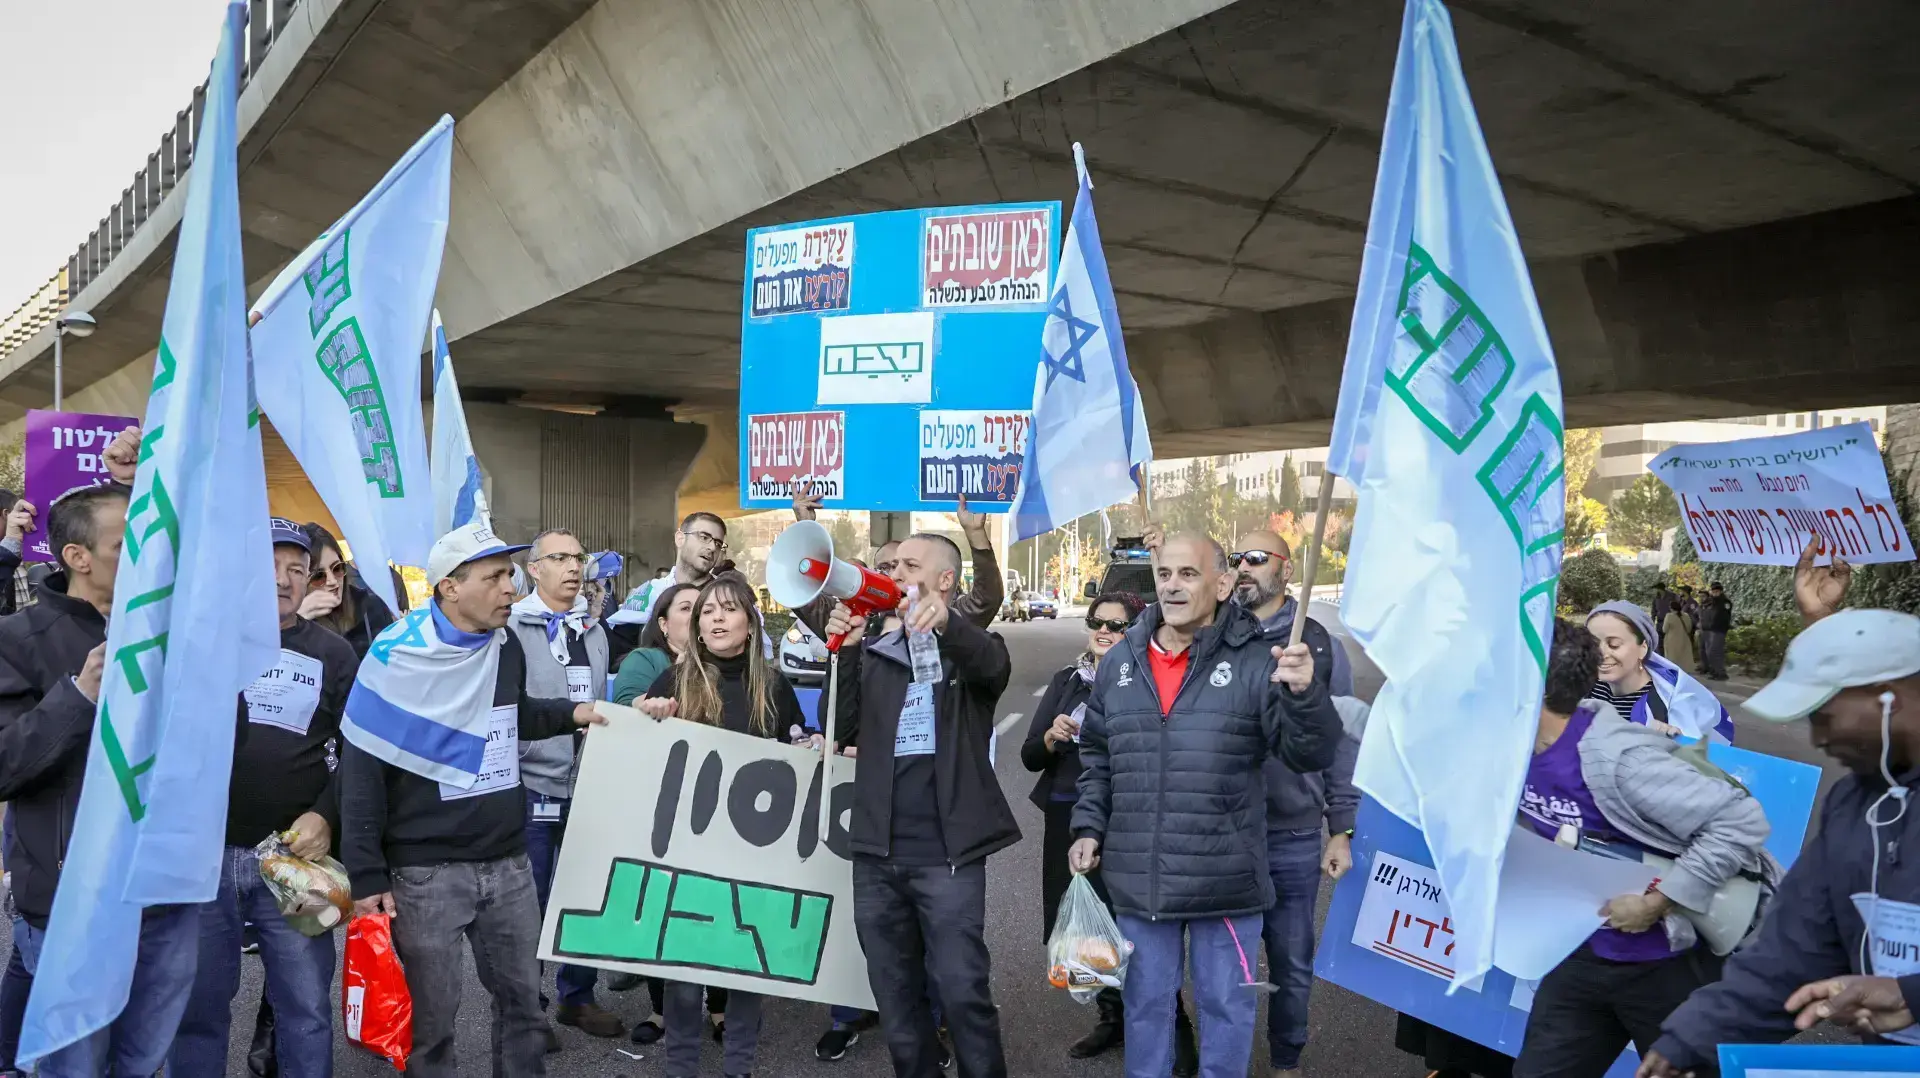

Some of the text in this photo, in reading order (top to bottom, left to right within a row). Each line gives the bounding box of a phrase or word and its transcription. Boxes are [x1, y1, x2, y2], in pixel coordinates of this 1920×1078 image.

[756, 238, 797, 268] מפעלים
[931, 217, 1043, 281] כאן שובתים
[756, 280, 780, 310] העם
[784, 277, 802, 306] את
[929, 279, 1041, 303] הנהלת טבע נכשלה
[52, 426, 121, 449] לטון
[923, 416, 976, 450] מפעלים
[752, 419, 839, 478] כאן שובתים
[1730, 456, 1770, 468] בירת
[752, 476, 780, 497] נכשלה
[926, 464, 957, 493] העם
[962, 464, 984, 493] את
[1787, 474, 1811, 492] היום
[1856, 487, 1901, 552] כל
[292, 672, 315, 686] טבע
[257, 703, 283, 713] עובדי
[909, 734, 928, 742] עובדי
[492, 768, 511, 778] עובדי
[552, 857, 834, 985] טבע
